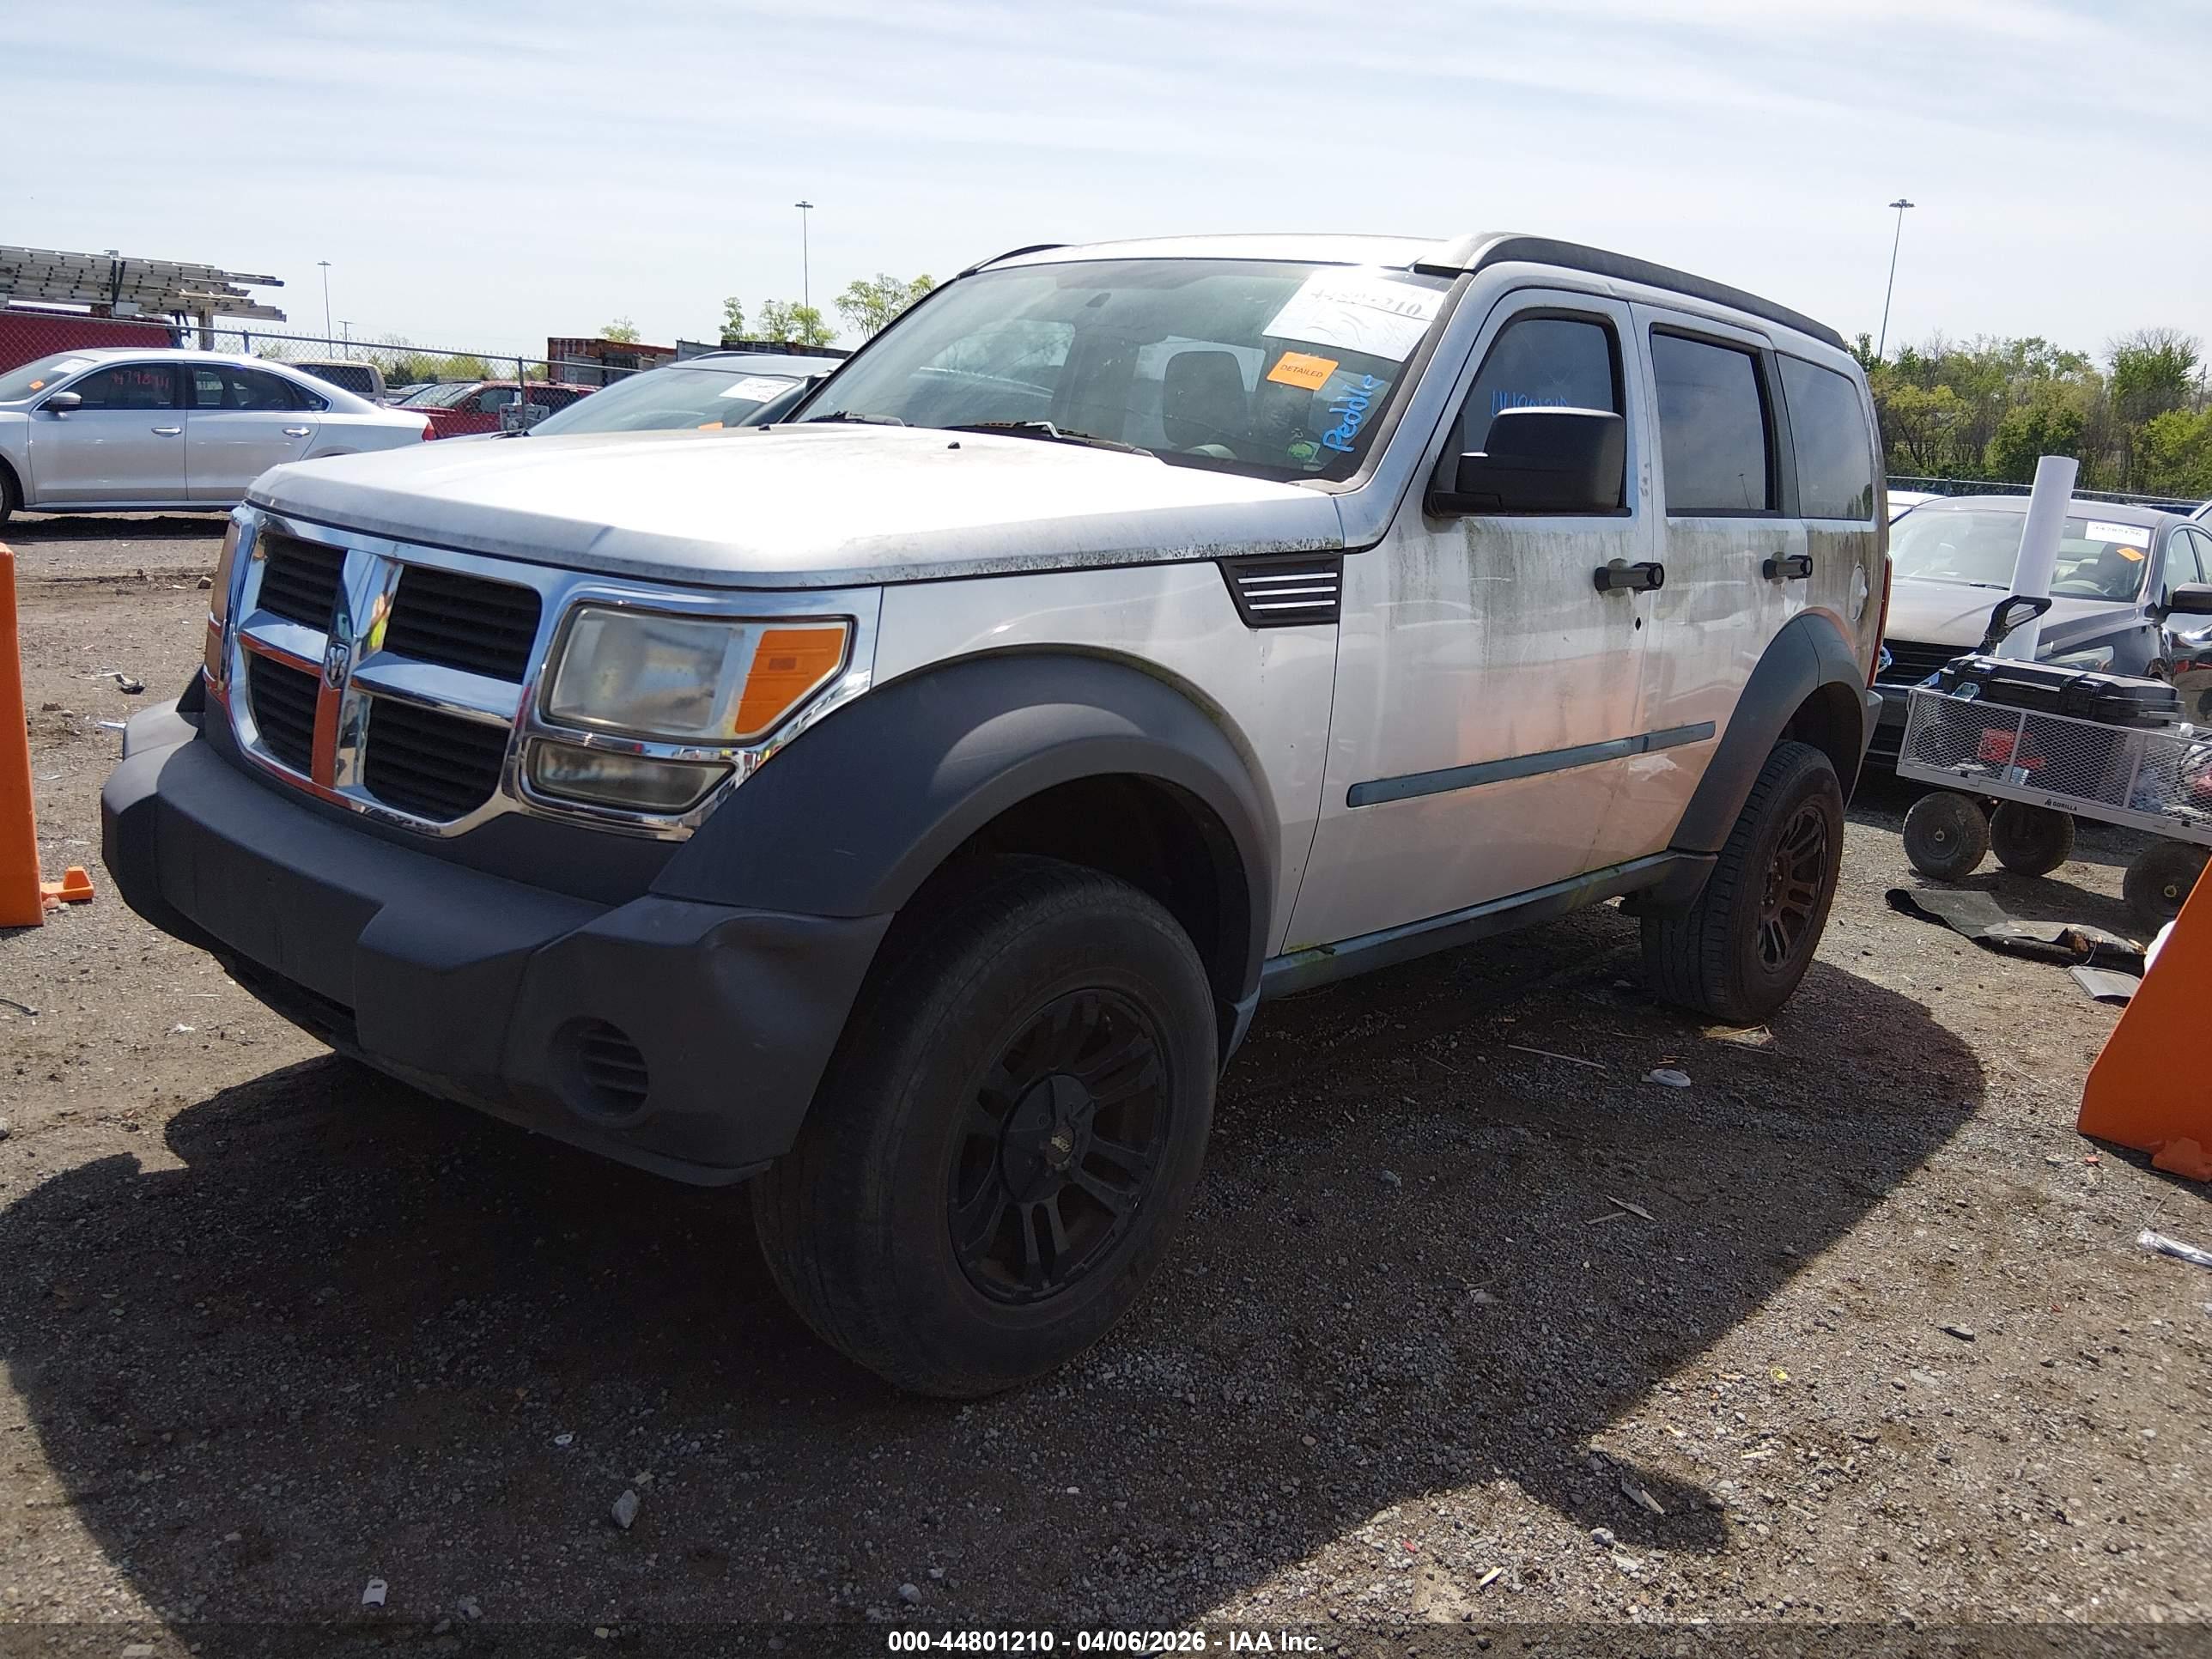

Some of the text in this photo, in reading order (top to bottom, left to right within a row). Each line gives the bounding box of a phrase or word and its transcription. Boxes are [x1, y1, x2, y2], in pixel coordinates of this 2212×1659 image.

[1279, 364, 1323, 379] DETAILED
[1322, 374, 1384, 453] Peddle
[2053, 801, 2077, 811] GORILLA
